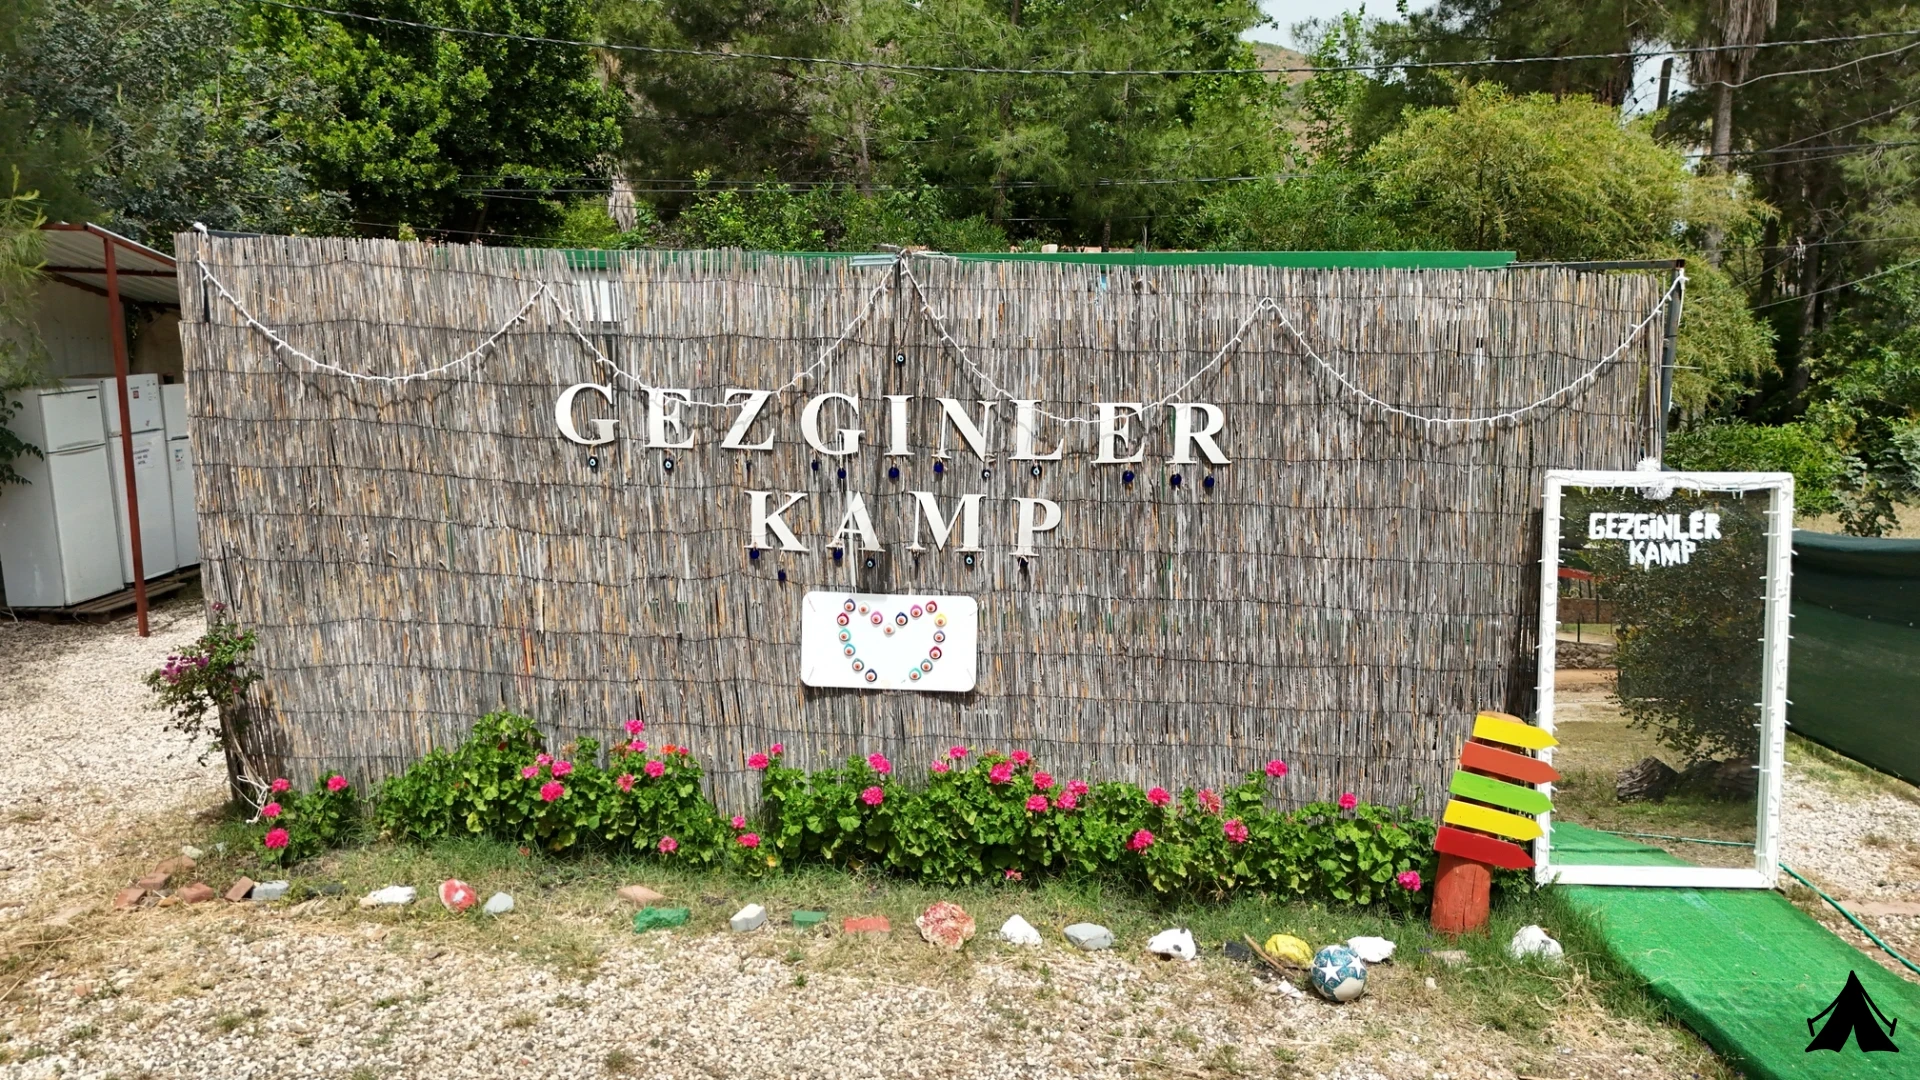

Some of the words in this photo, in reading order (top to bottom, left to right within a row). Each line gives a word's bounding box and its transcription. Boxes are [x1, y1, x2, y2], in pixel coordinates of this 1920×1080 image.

[555, 382, 1232, 464] GEZGINLER
[744, 490, 1062, 557] KAMP
[1629, 538, 1696, 571] KAMP
